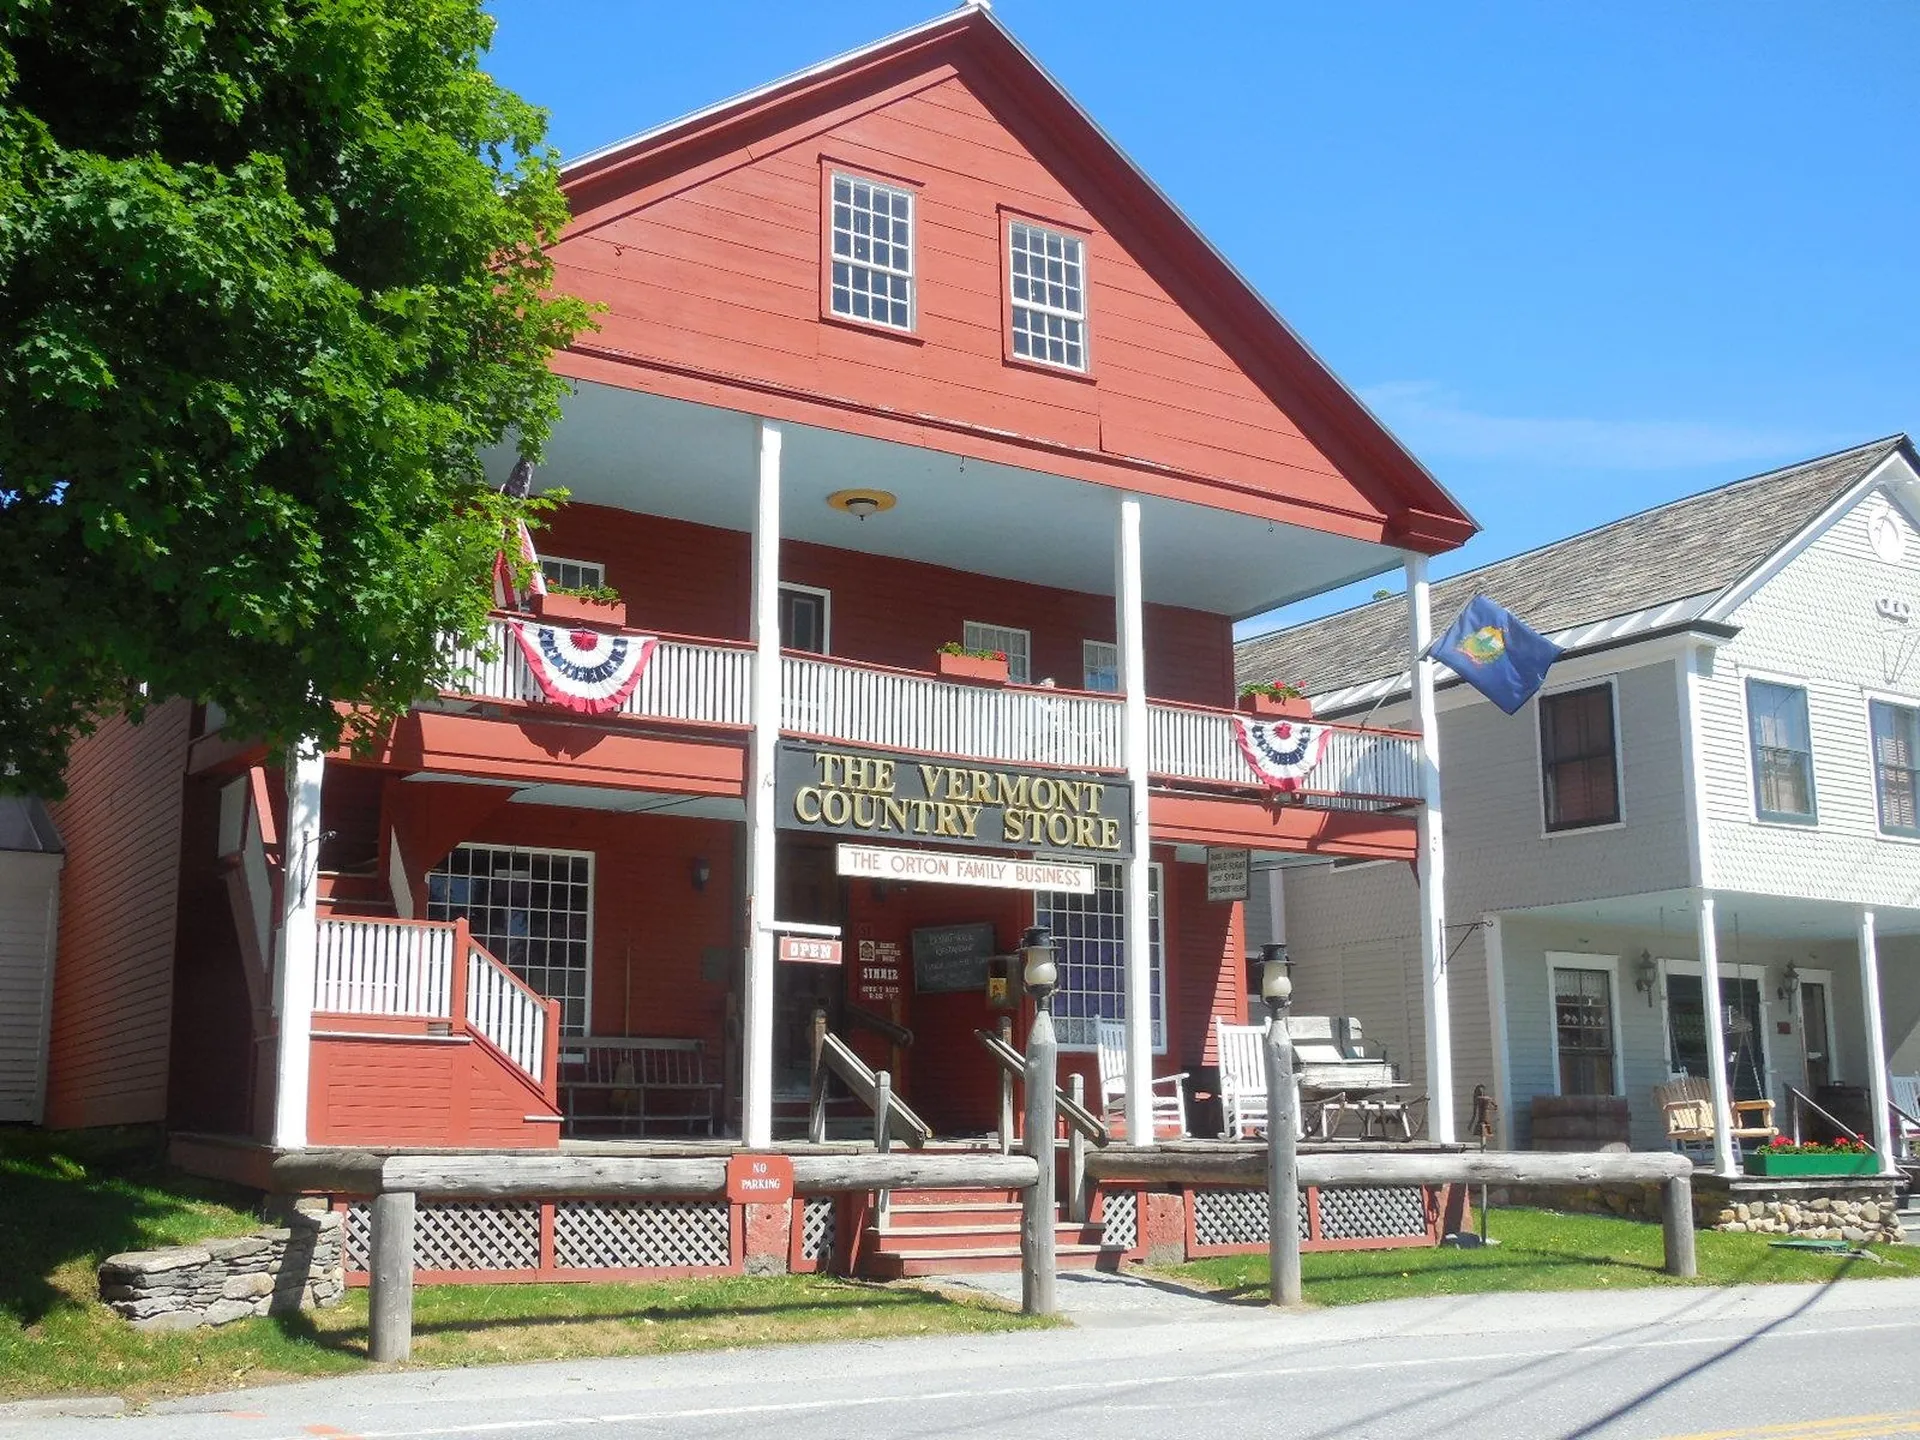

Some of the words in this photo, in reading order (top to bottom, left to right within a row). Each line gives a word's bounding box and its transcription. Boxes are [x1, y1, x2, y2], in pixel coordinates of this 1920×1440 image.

[814, 752, 896, 793] THE
[918, 763, 1105, 816] VERMONT
[795, 786, 983, 838] COUNTRY
[1002, 808, 1122, 850] STORE
[851, 851, 880, 870] THE
[890, 854, 949, 876] ORTON
[956, 860, 1007, 880] FAMILY
[1015, 867, 1081, 888] BUSINESS
[789, 940, 832, 960] OPEN
[752, 1162, 767, 1174] NO
[741, 1178, 780, 1190] PARKING
